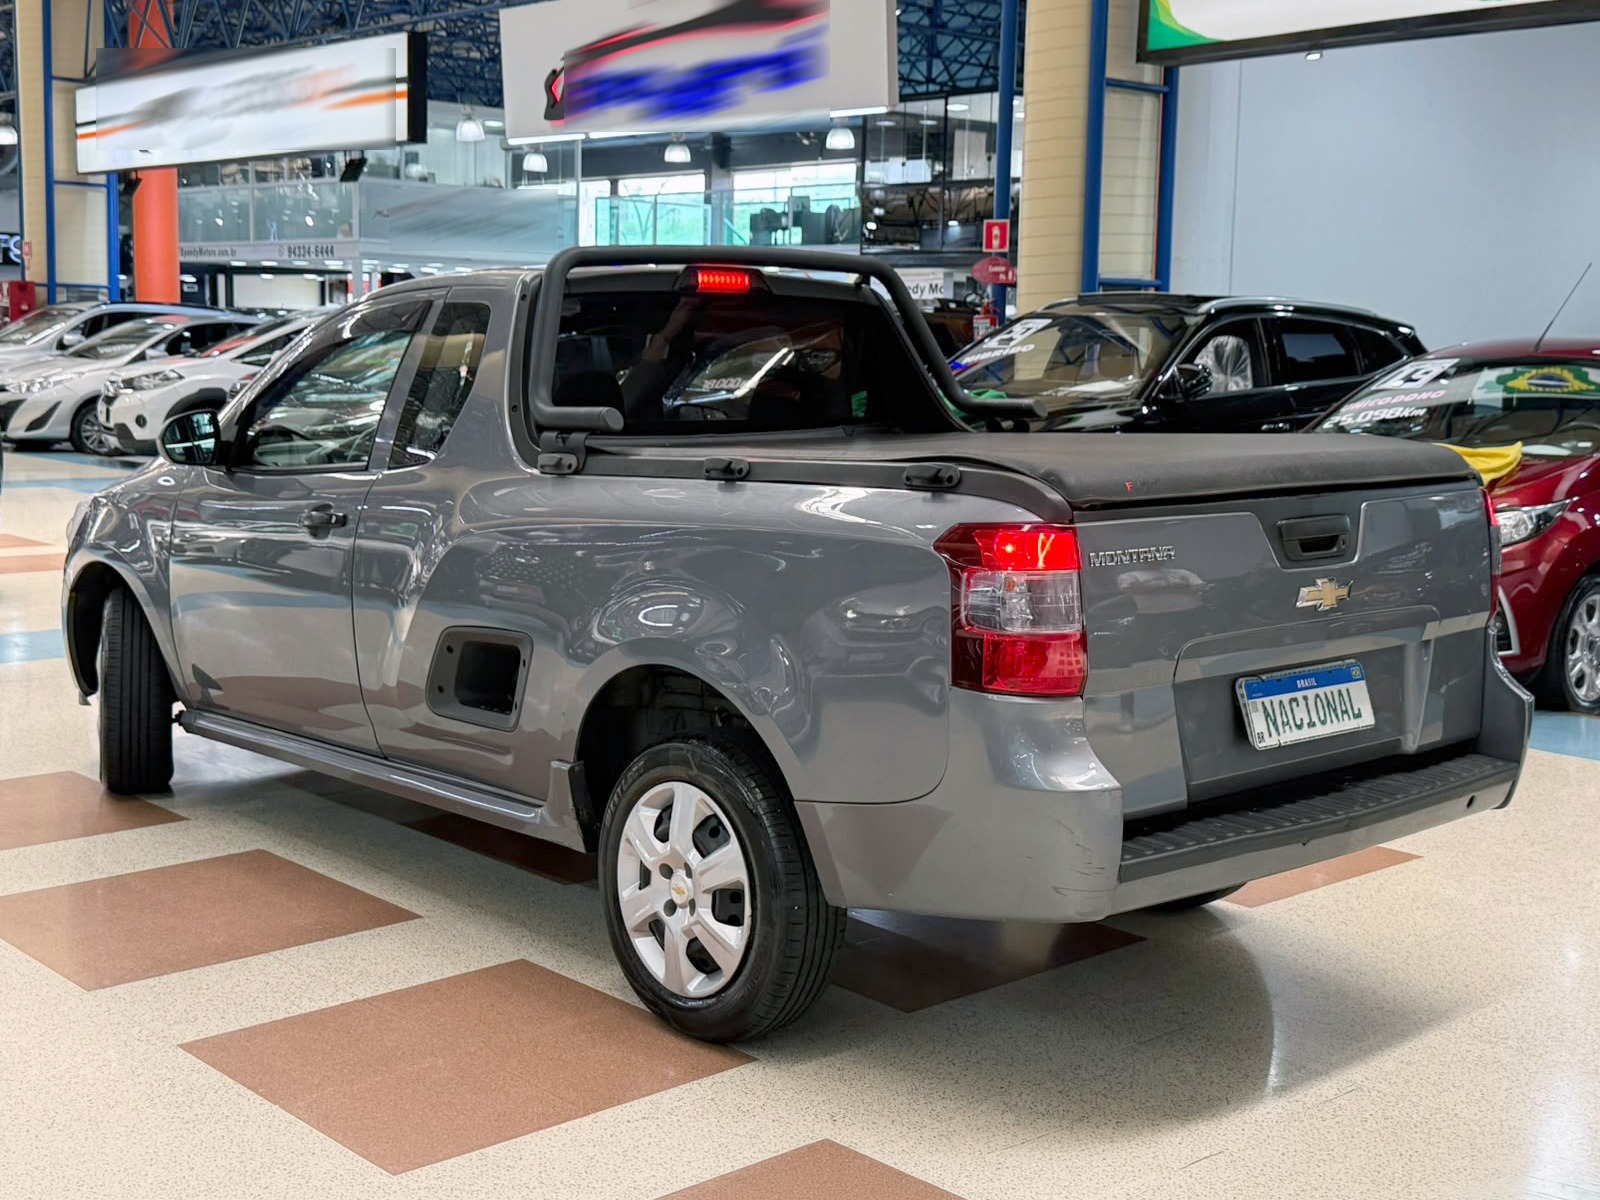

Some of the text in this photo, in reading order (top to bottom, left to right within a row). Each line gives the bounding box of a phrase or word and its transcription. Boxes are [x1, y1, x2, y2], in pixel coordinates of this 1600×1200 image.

[1088, 545, 1177, 567] MONTANA
[1296, 677, 1318, 689] BRASIL
[1261, 687, 1363, 738] NACIONAL
[1256, 731, 1266, 744] BR
